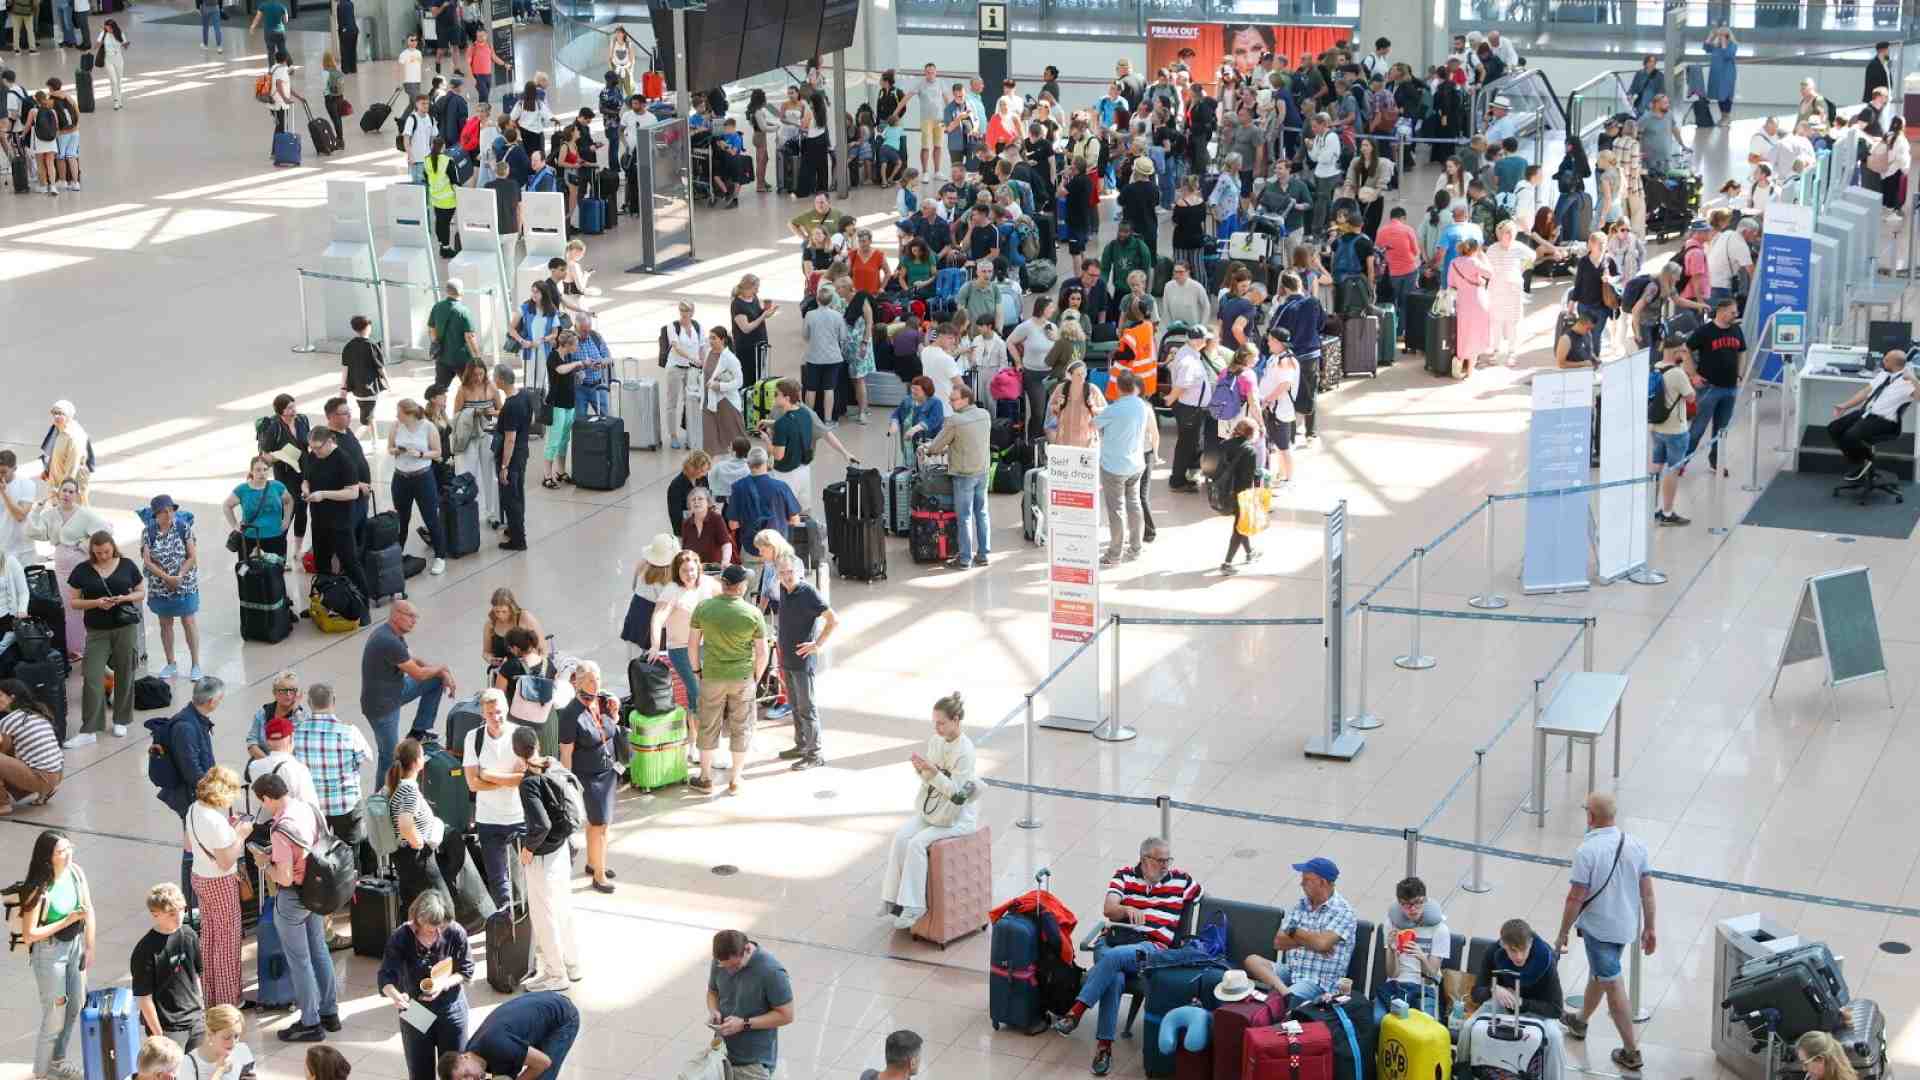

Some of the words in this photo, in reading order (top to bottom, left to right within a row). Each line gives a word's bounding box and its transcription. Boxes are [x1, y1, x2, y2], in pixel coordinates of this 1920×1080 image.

[1152, 26, 1178, 34] FREAK
[1050, 455, 1069, 466] Self
[1050, 467, 1069, 480] bag
[1071, 469, 1095, 480] drop
[1385, 1042, 1405, 1072] BVB
